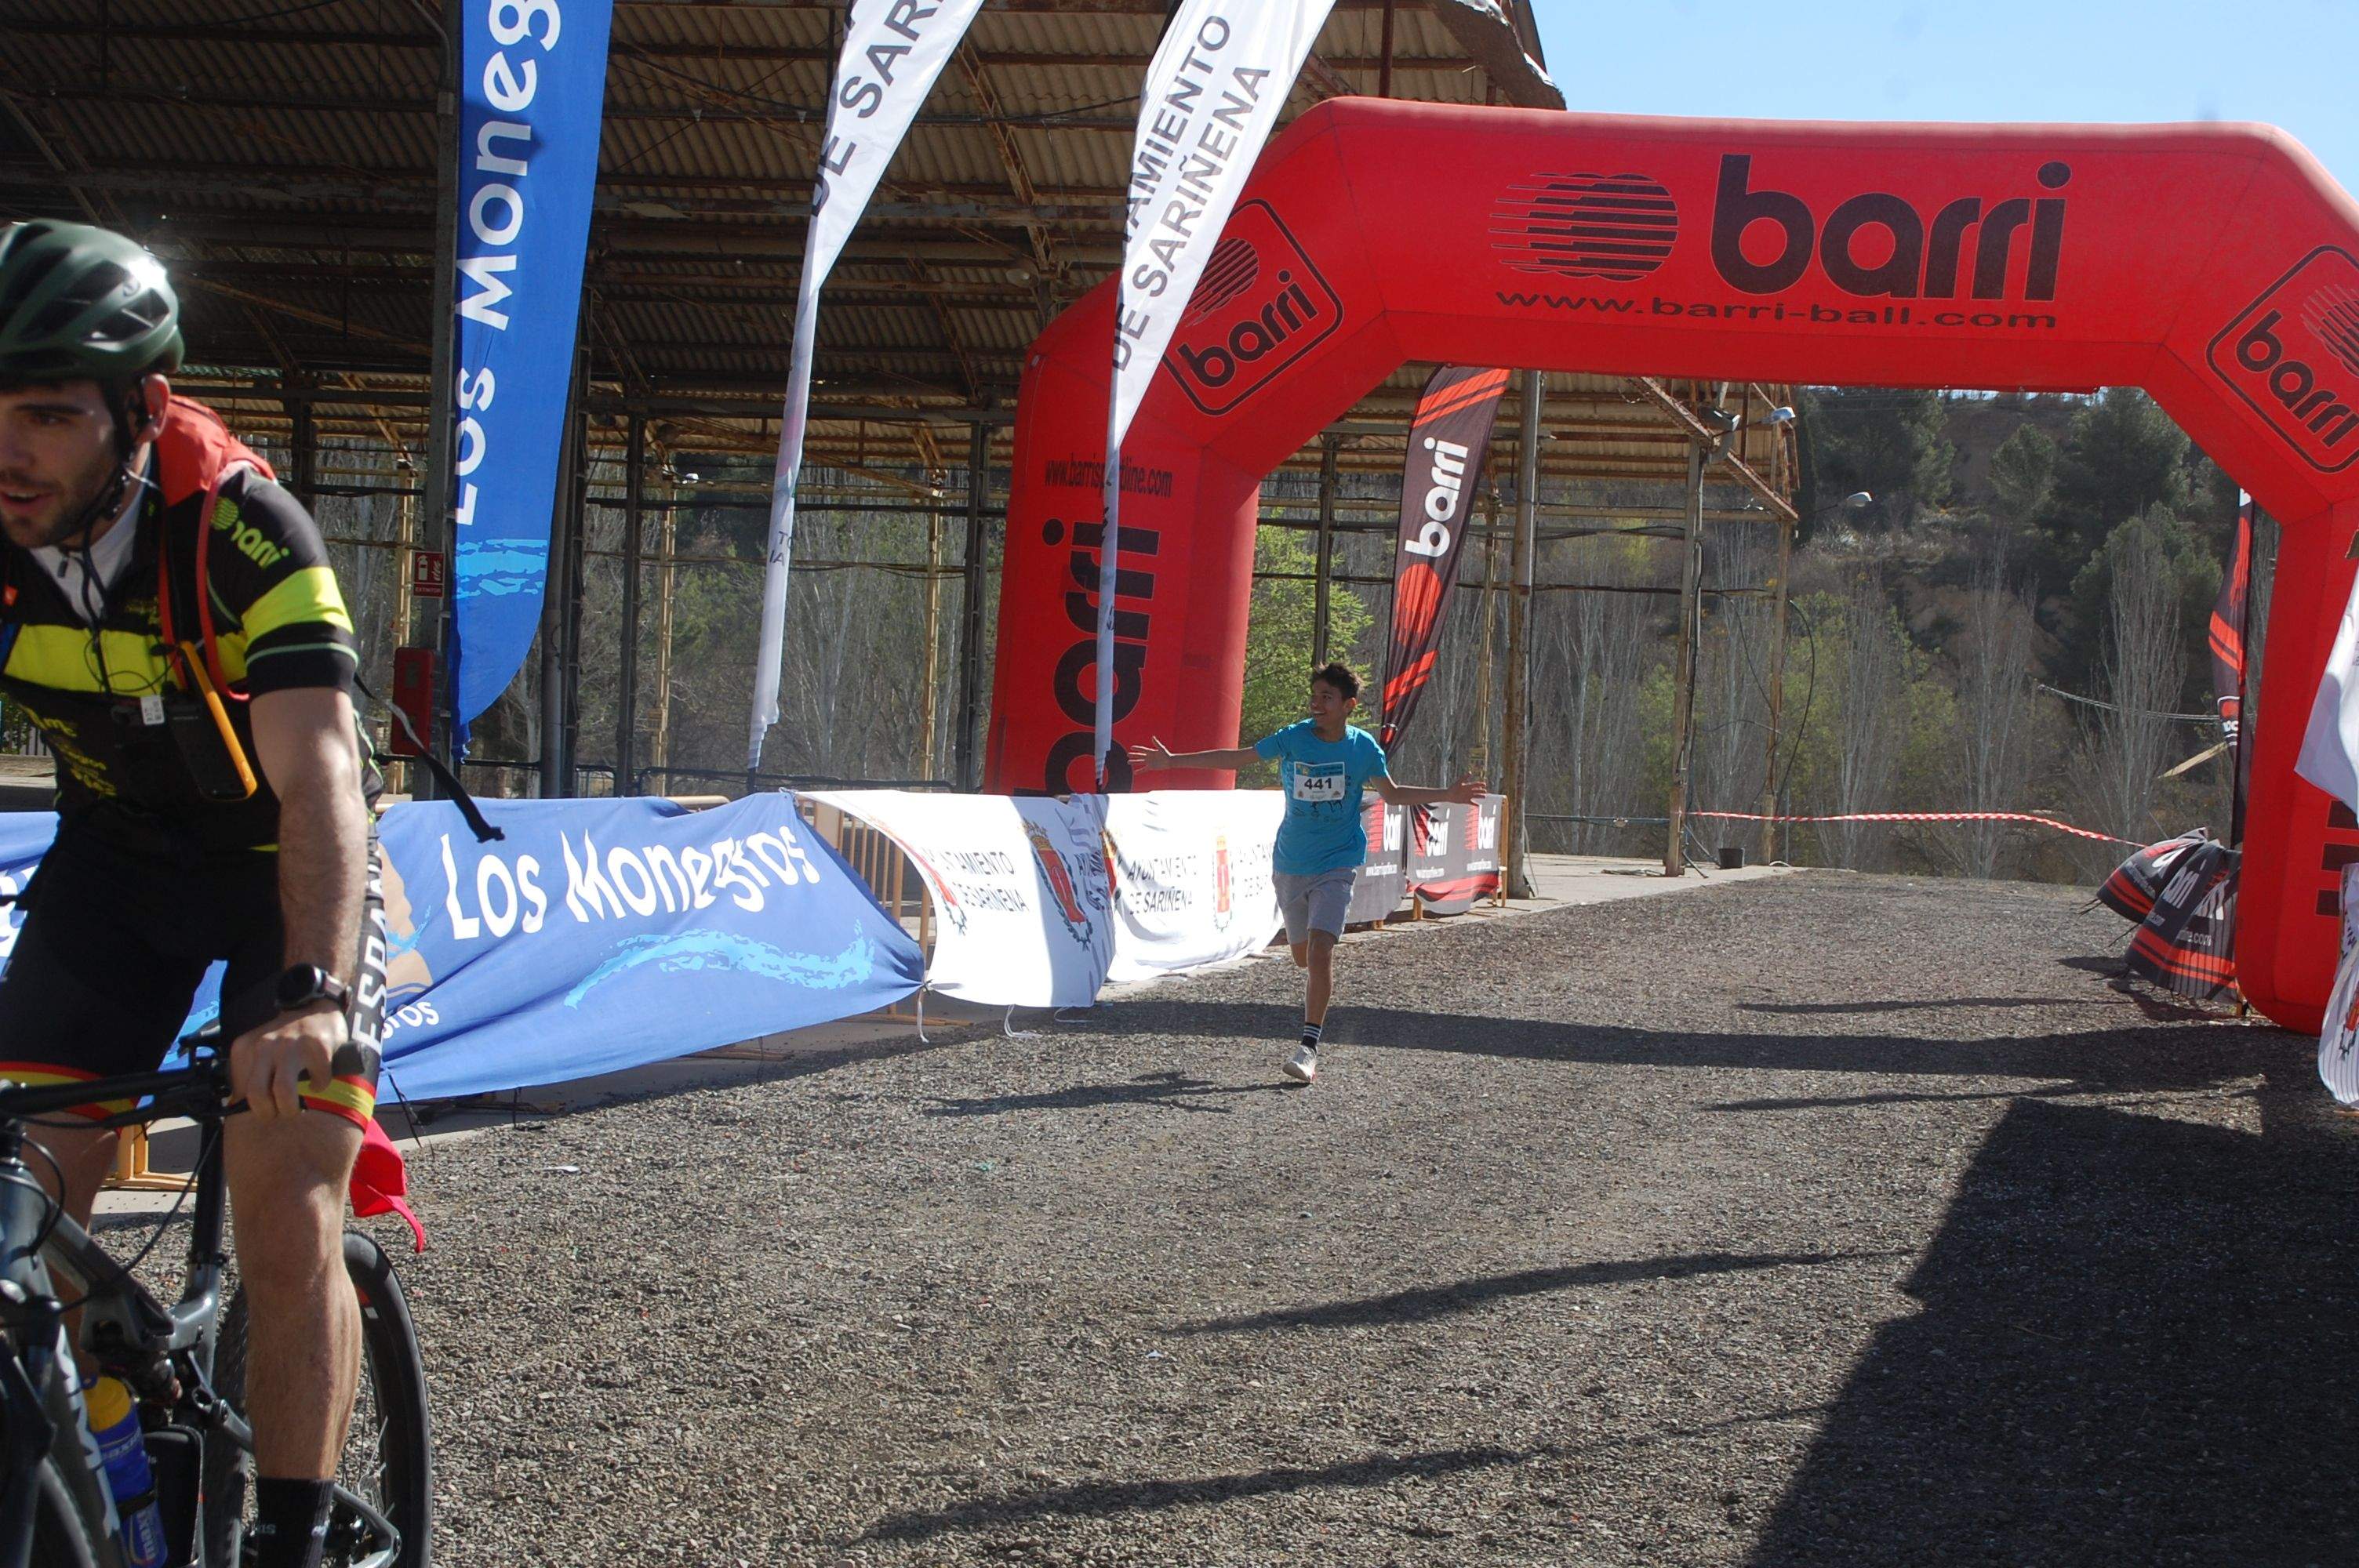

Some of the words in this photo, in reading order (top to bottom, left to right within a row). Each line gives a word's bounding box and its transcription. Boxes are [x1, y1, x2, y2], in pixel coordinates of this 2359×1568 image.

[839, 0, 942, 119] SAR
[1124, 15, 1231, 237] AMIENTO
[1132, 66, 1271, 298] SARIÑENA
[1710, 153, 2072, 302] barri
[1176, 269, 1319, 389] barri
[1496, 291, 2056, 329] www.barri-ball.com
[1405, 437, 1469, 557] barri
[1303, 777, 1332, 790] 441
[1478, 804, 1496, 850] barri
[440, 832, 547, 941] Los
[560, 825, 820, 923] Monegros
